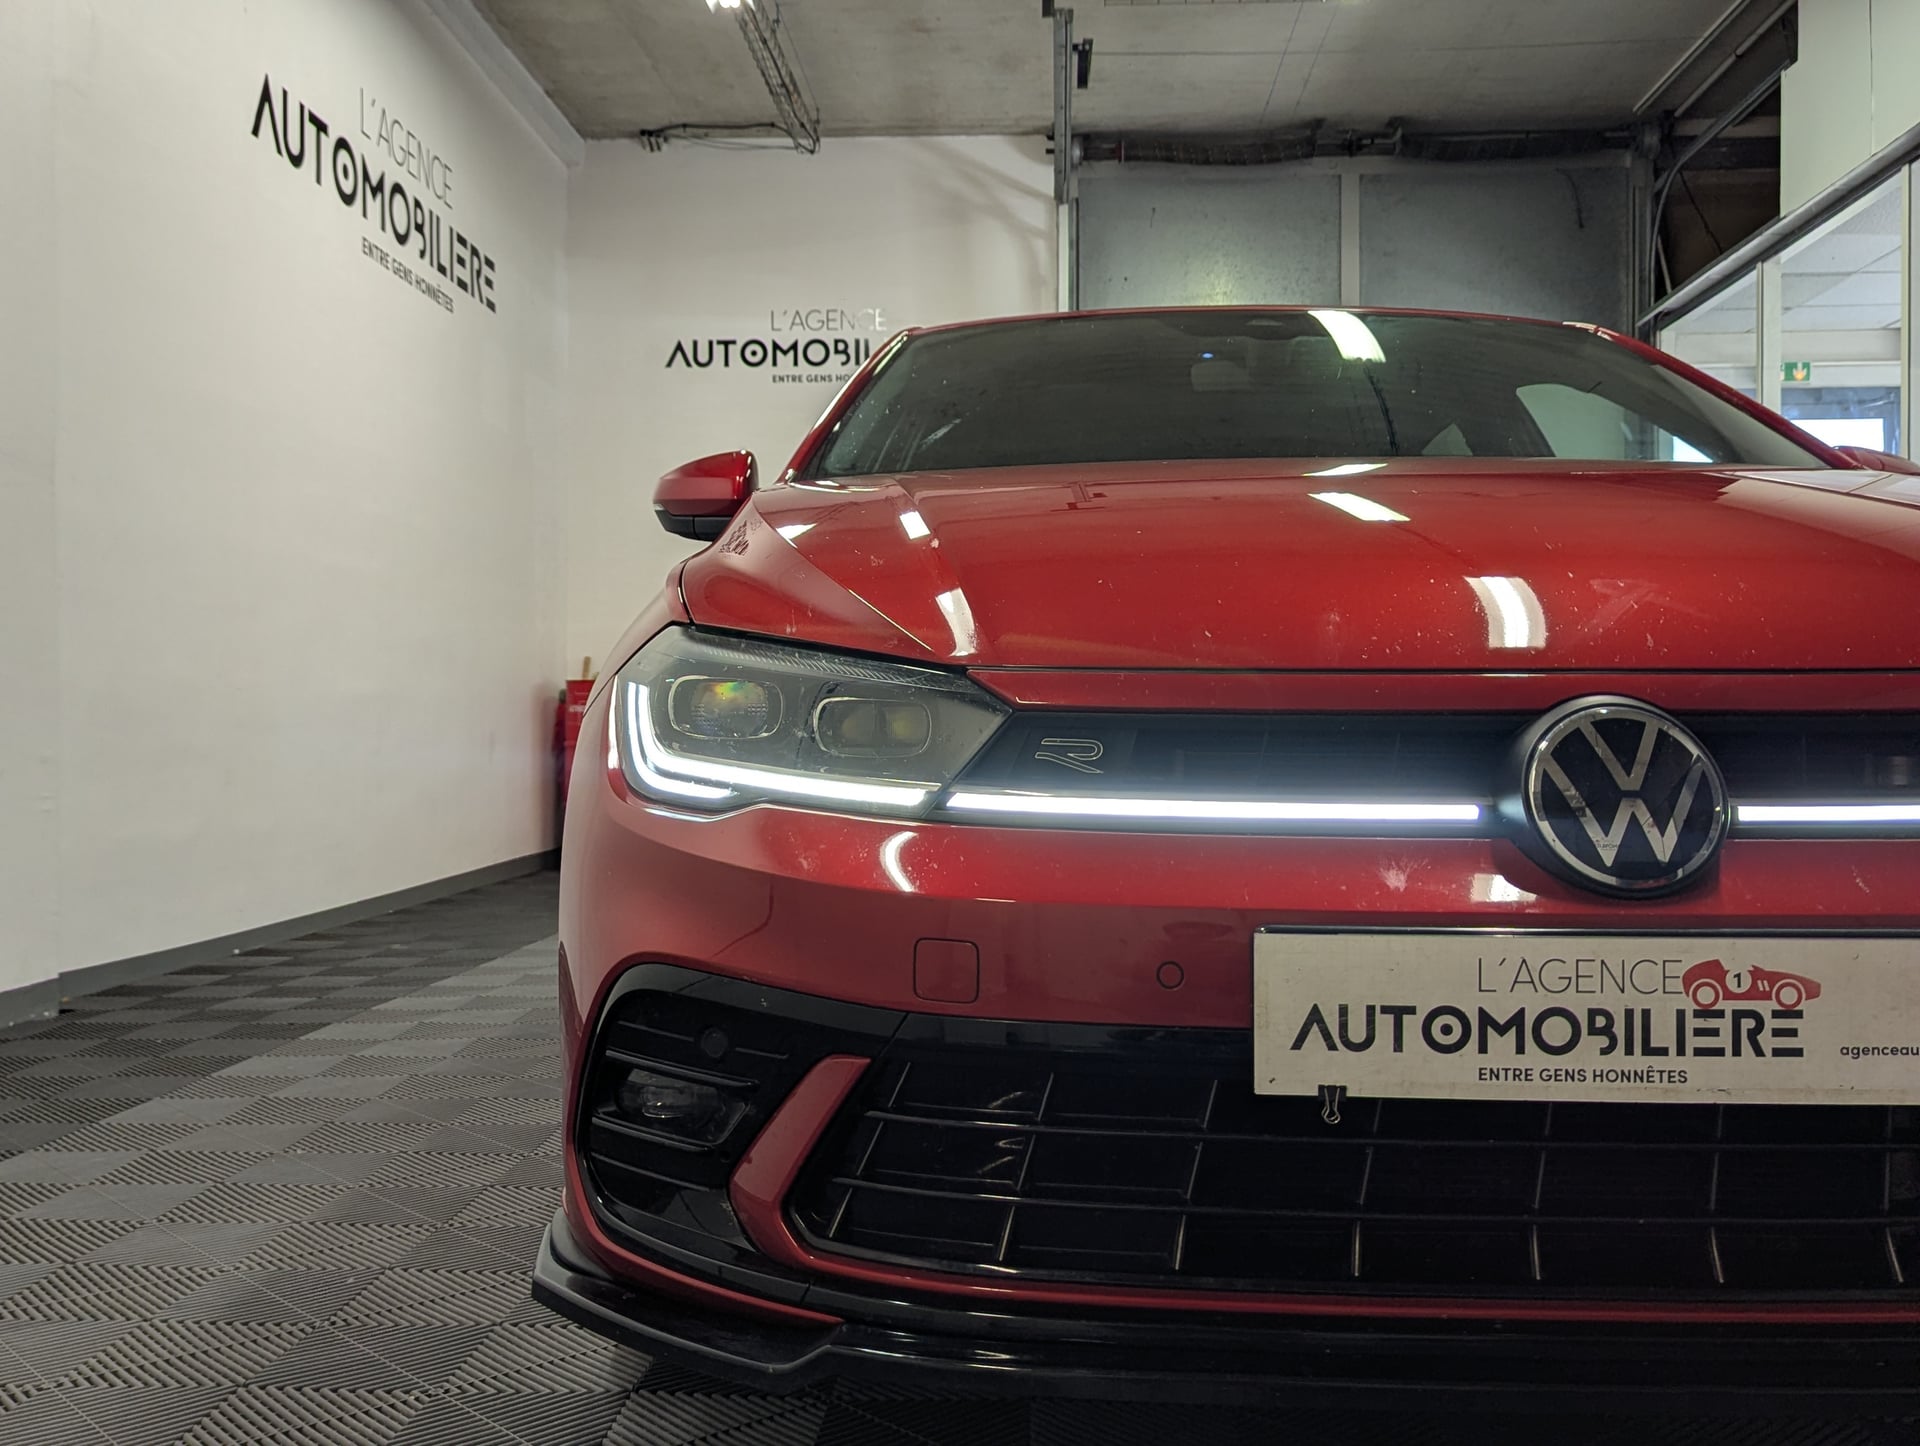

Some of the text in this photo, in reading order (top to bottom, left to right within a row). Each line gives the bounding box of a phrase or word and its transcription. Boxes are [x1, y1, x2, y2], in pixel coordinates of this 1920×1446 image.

[360, 87, 453, 210] L'AGENCE
[251, 73, 496, 314] AUTOMOBILIERE
[362, 236, 390, 270] ENTRE
[392, 258, 413, 286] GENS
[772, 374, 803, 383] ENTRE
[806, 374, 832, 383] GENS
[1478, 957, 1683, 995] L'AGENCE
[1290, 1003, 1804, 1058] AUTOMOBILIERE
[1478, 1065, 1688, 1084] ENTRE GENS HONNÊTES
[1840, 1046, 1920, 1060] agenceau
